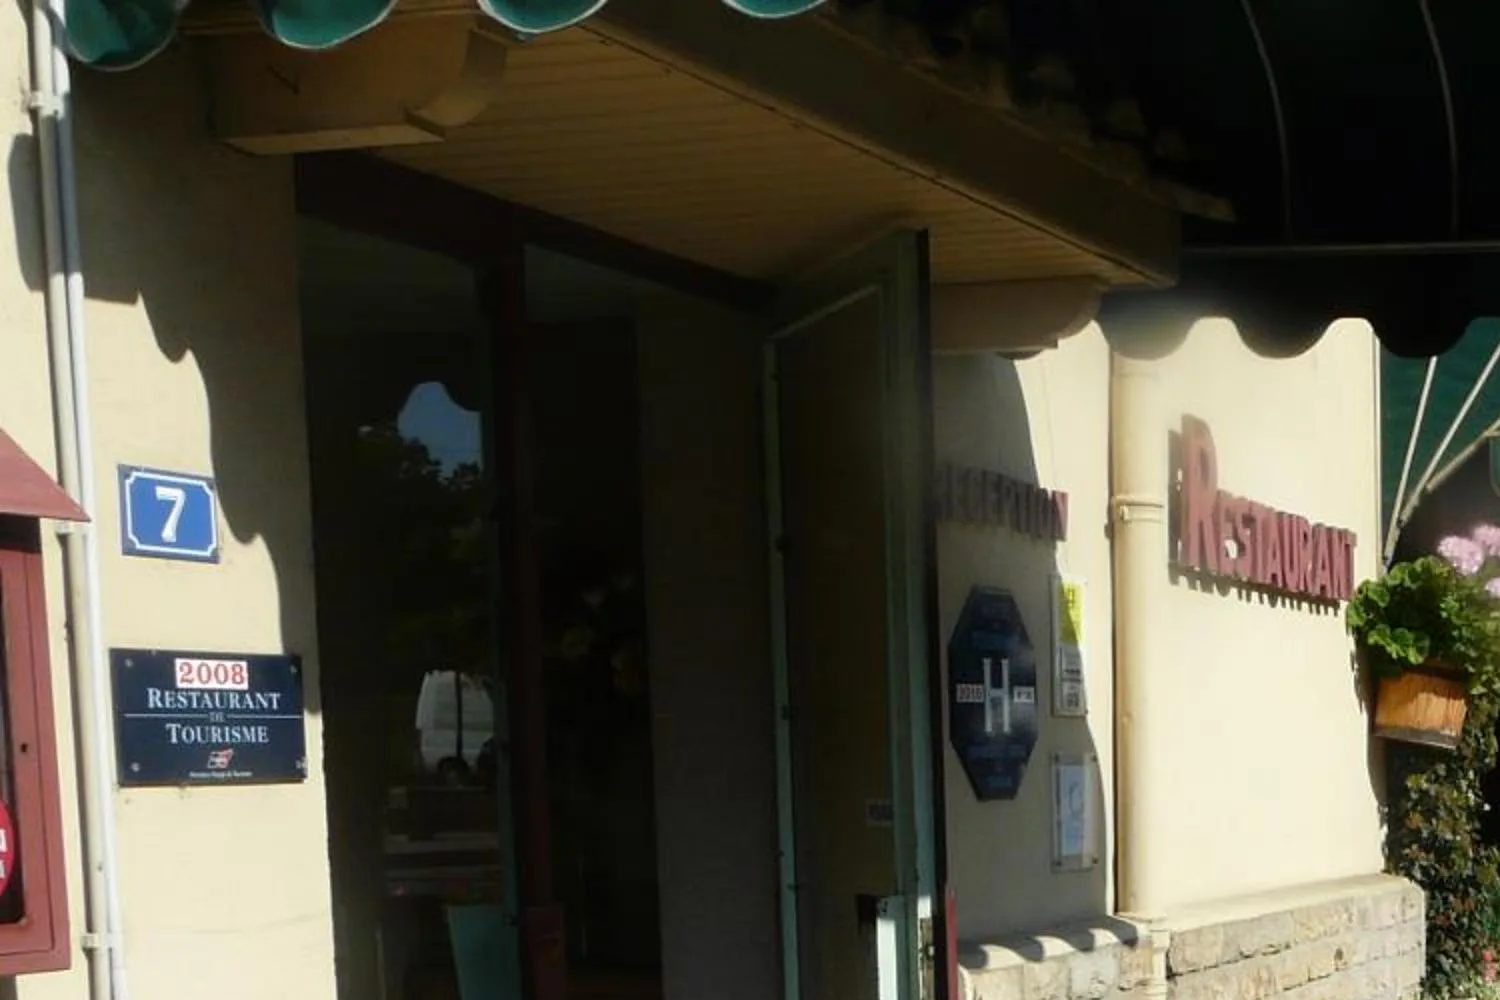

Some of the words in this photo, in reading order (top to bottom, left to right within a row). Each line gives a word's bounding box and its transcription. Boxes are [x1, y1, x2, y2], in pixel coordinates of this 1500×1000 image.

[155, 486, 187, 543] 7
[1179, 413, 1358, 602] RESTAURANT
[179, 662, 246, 686] 2008
[147, 688, 281, 711] RESTAURANT
[165, 723, 270, 744] TOURISME
